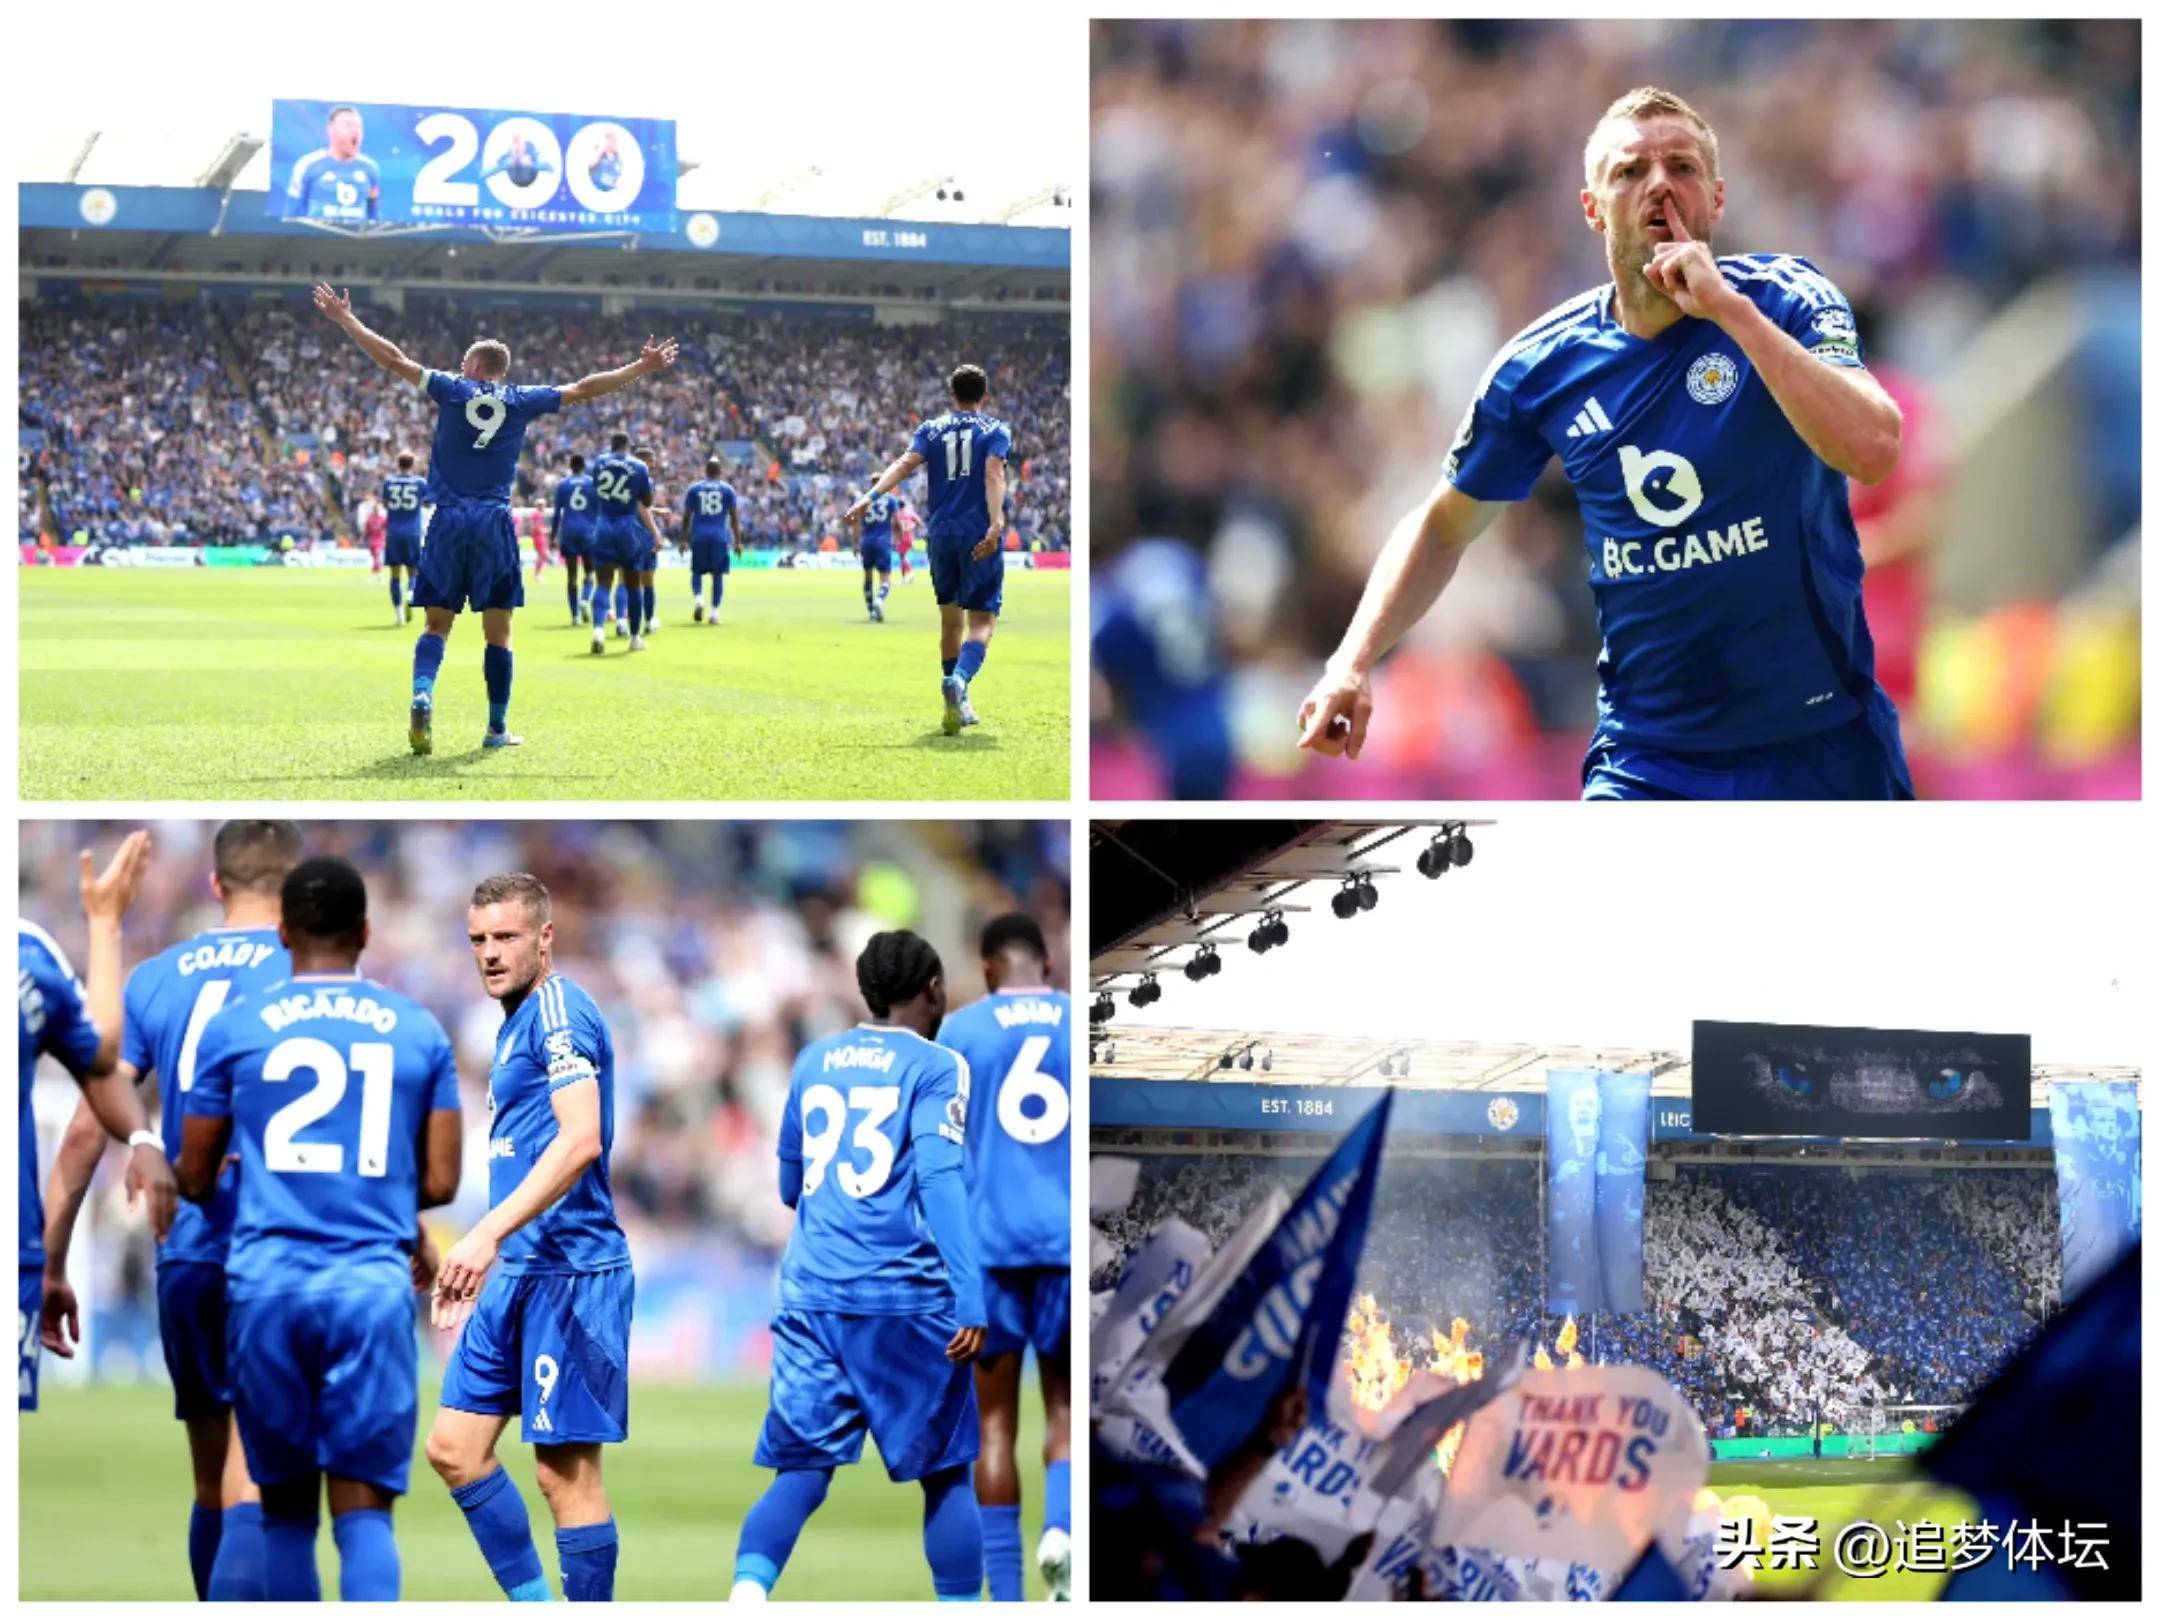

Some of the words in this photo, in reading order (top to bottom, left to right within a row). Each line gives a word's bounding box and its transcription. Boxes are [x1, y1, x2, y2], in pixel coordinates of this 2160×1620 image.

[412, 112, 645, 214] 200
[465, 395, 506, 448] 9
[941, 428, 973, 481] 11
[386, 484, 419, 510] 35
[569, 485, 588, 511] 6
[597, 469, 632, 504] 24
[698, 490, 723, 516] 18
[1602, 516, 1769, 579] BC.GAME
[177, 943, 275, 976] COADY
[260, 994, 398, 1033] RICARDO
[262, 1037, 394, 1178] 21
[997, 1036, 1070, 1144] 6
[1261, 1099, 1291, 1114] EST.
[1296, 1100, 1333, 1116] 1884
[801, 1084, 900, 1200] 93
[534, 1354, 559, 1404] 9
[1617, 1397, 1669, 1438] YOU
[1503, 1429, 1657, 1492] VARDS
